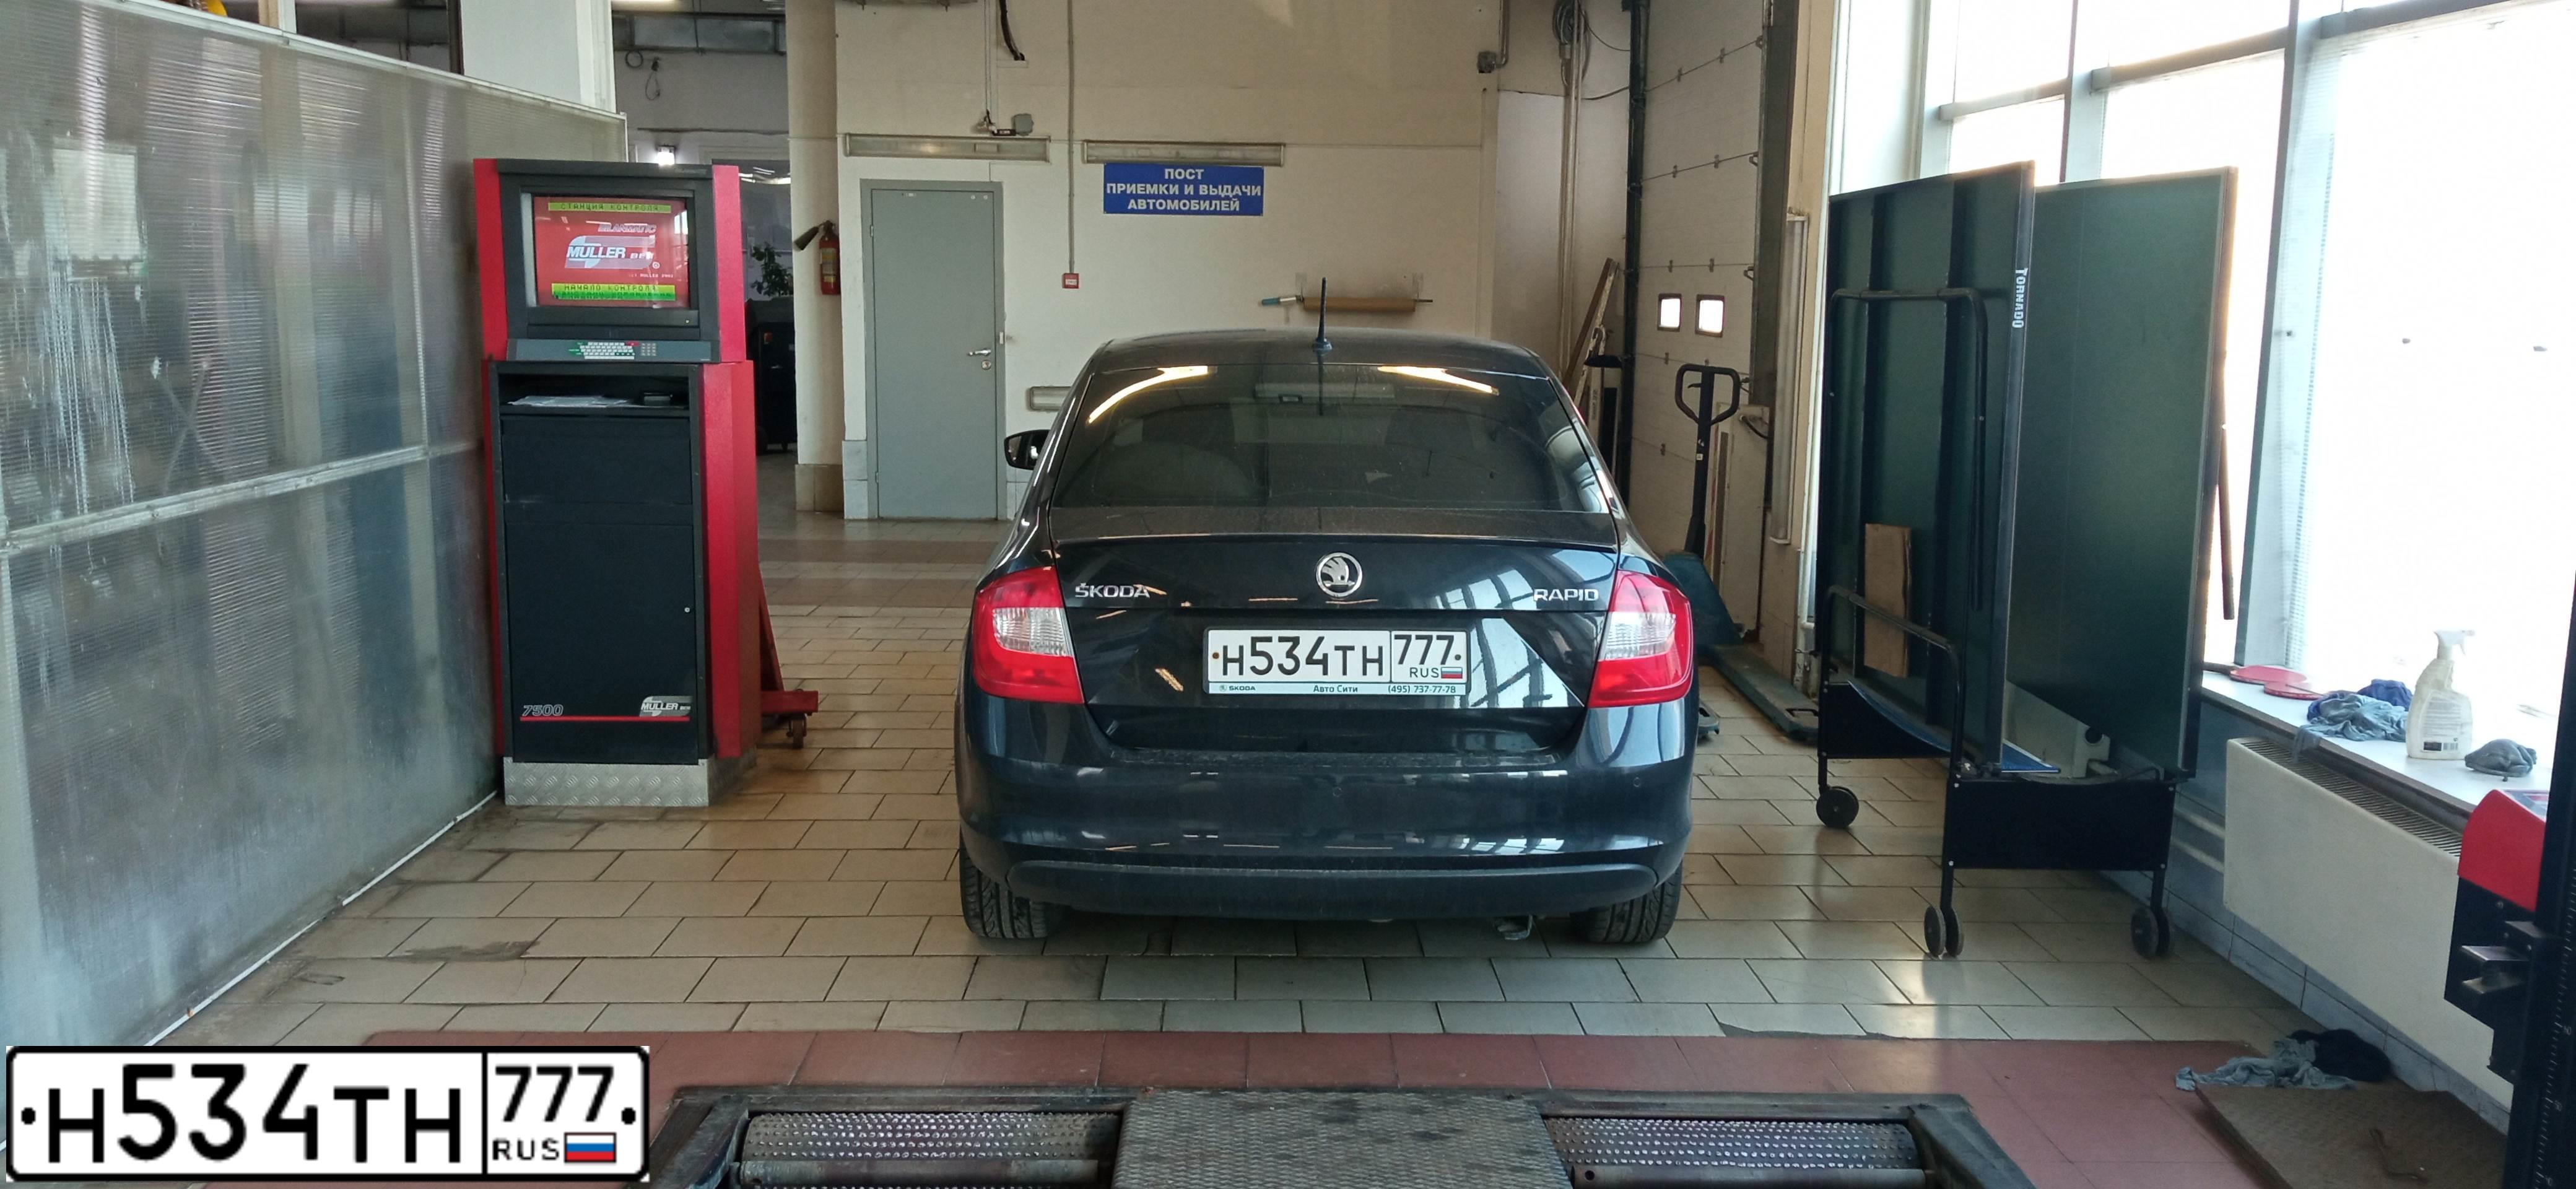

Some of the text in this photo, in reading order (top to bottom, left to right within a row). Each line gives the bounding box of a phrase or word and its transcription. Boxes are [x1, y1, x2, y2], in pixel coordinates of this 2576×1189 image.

[1164, 168, 1204, 180] ПОСТ
[1107, 183, 1261, 198] ПРИЕМКИ И ВЫДАЧИ
[560, 203, 604, 211] СТАНЦИЯ
[1127, 198, 1240, 211] АВТОМОБИЛЕЙ
[567, 246, 626, 258] MULLER
[2012, 268, 2028, 328] TORNADO
[1534, 589, 1598, 601] RAPID
[1222, 634, 1455, 676] Н534ТН 777
[1409, 667, 1439, 678] RUS
[1388, 685, 1456, 694] (495) 737-77-78
[522, 704, 564, 716] 7500
[641, 702, 679, 710] MULLER
